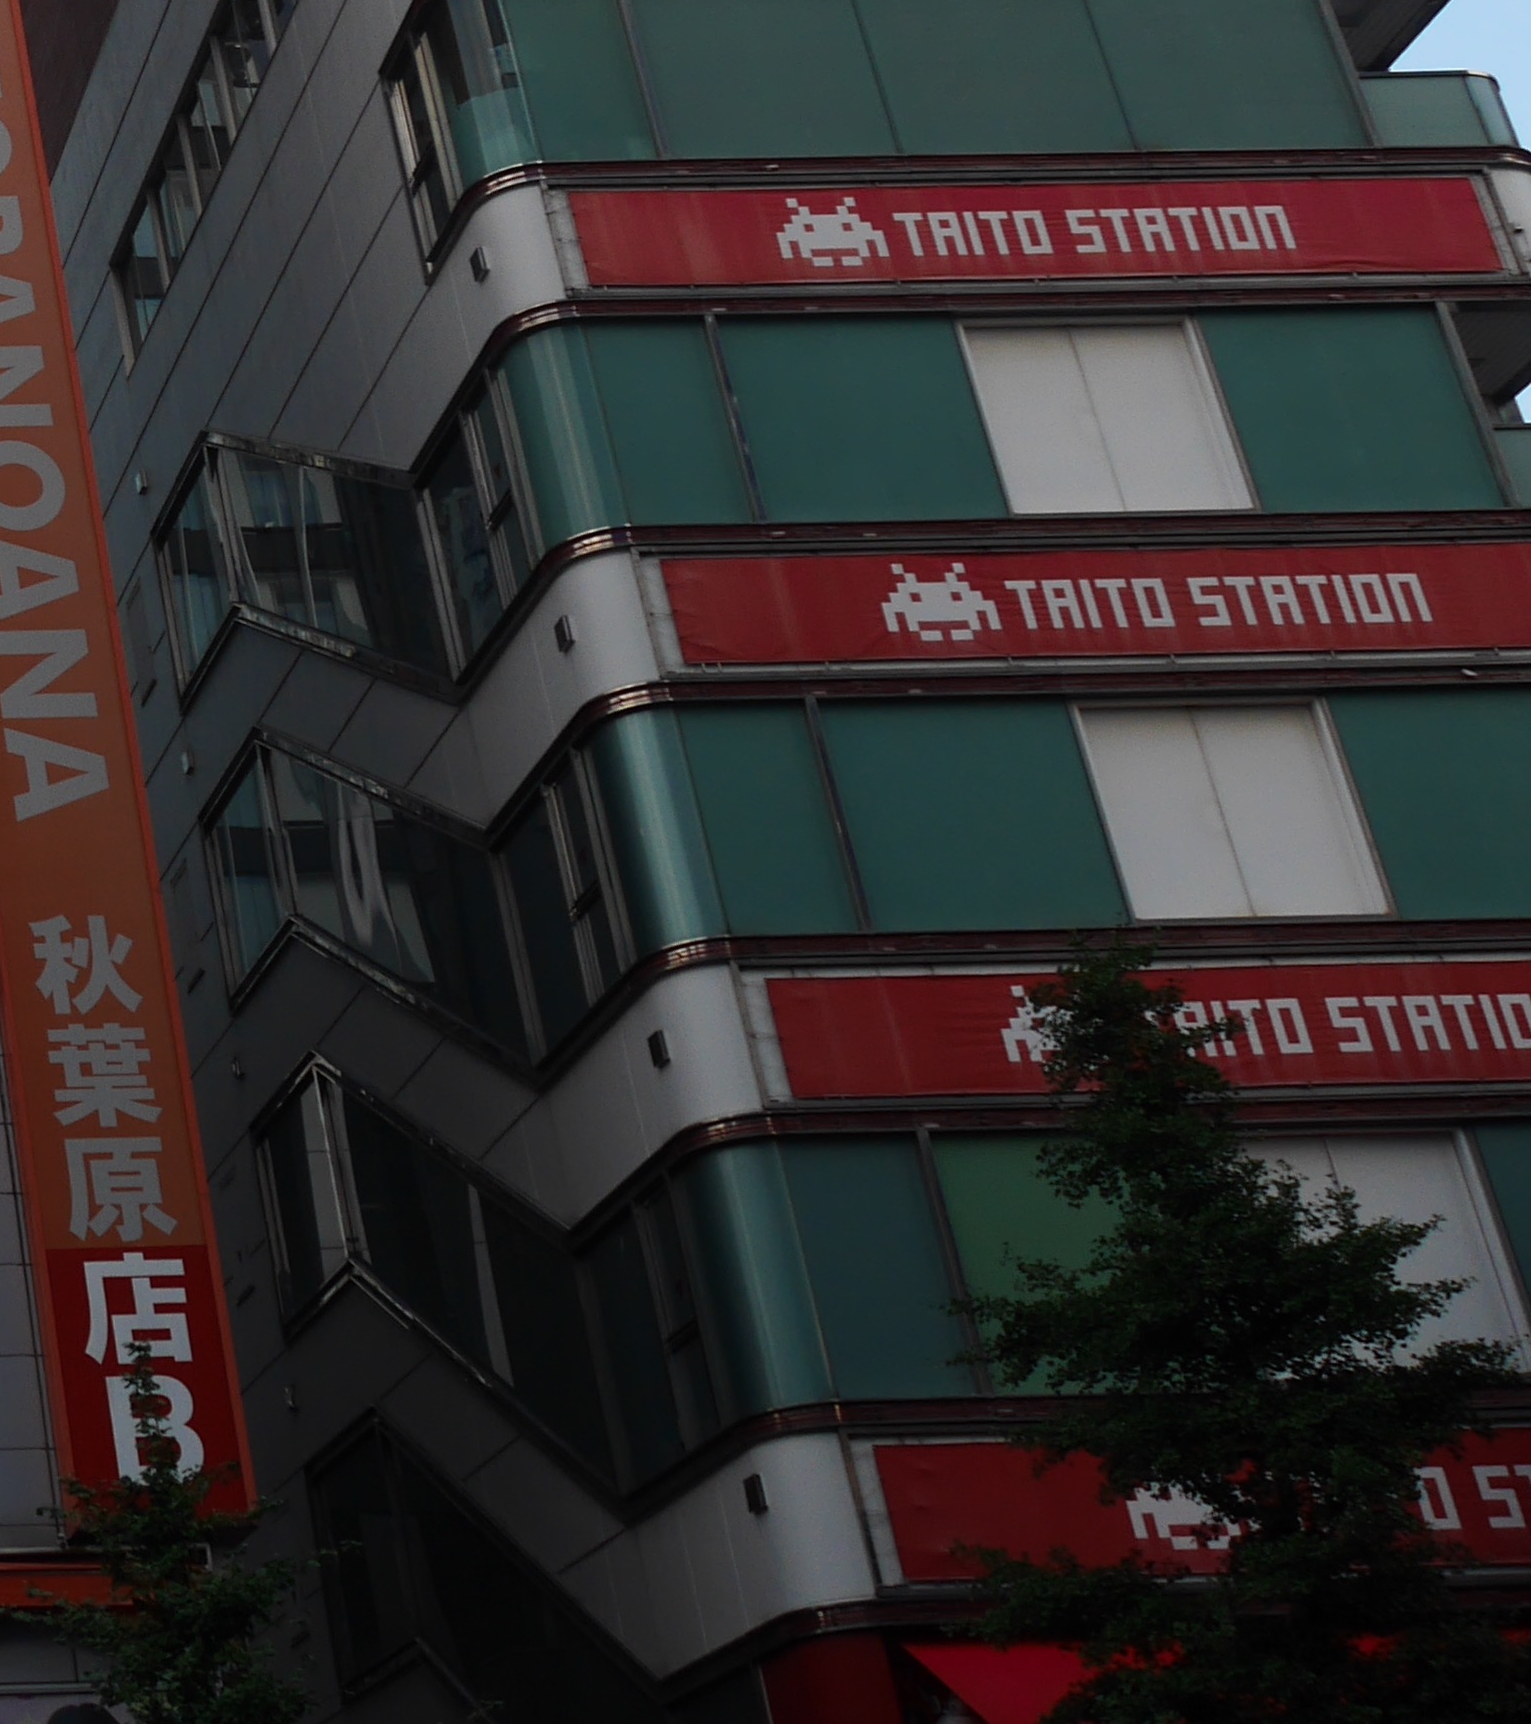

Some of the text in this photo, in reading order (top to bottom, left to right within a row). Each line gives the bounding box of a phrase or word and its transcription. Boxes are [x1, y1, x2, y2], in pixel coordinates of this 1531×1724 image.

[893, 205, 1297, 257] TAITO STATION
[1004, 572, 1433, 631] TAITO STATION
[1143, 997, 1315, 1058] AITO
